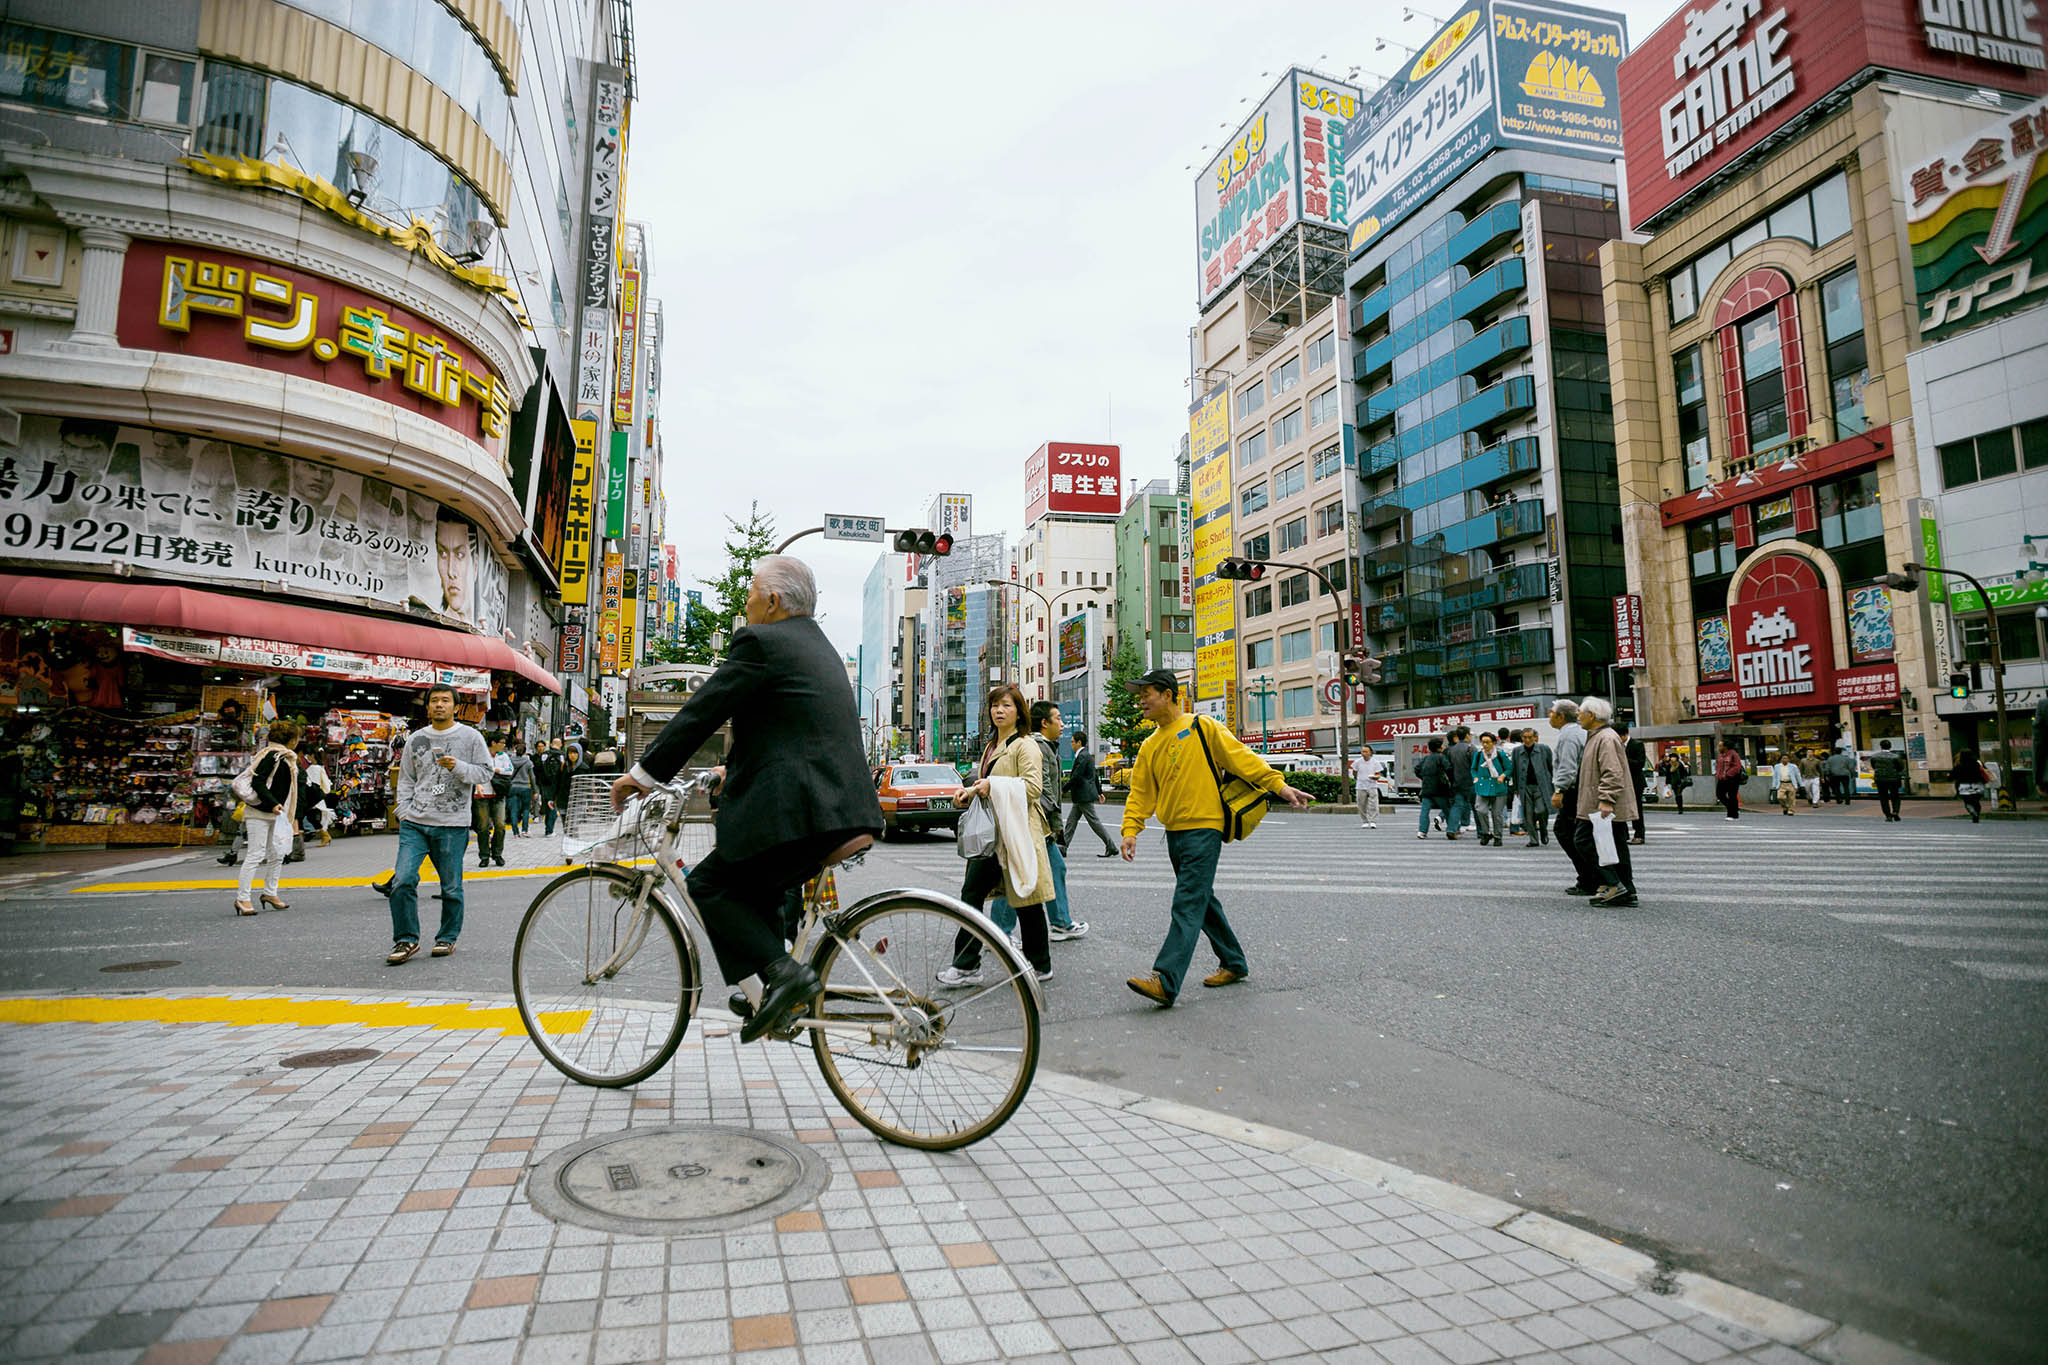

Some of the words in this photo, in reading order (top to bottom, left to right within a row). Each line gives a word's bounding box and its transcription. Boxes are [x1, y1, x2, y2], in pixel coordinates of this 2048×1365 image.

[1925, 25, 1976, 56] TAITO
[1977, 36, 2046, 71] STATION
[1660, 7, 1792, 160] GAME
[1665, 131, 1714, 180] TAITO
[1715, 71, 1796, 145] STATION
[1327, 119, 1348, 225] SUNPARK
[1201, 141, 1291, 262] SUNPARK
[581, 331, 603, 400] 北の家族
[1057, 452, 1110, 467] クスリの
[611, 467, 622, 500] レイク
[4, 513, 233, 568] 9月22日発売
[829, 517, 880, 532] 歌舞伎町
[838, 530, 871, 539] Kabukicho
[255, 550, 384, 593] kurohyo.jp
[605, 585, 619, 609] 麻雀
[621, 626, 633, 663] プロミス
[1737, 643, 1813, 687] GAME
[1740, 686, 1768, 699] TAITO
[1769, 680, 1815, 696] STATION
[1382, 723, 1416, 737] クスリの
